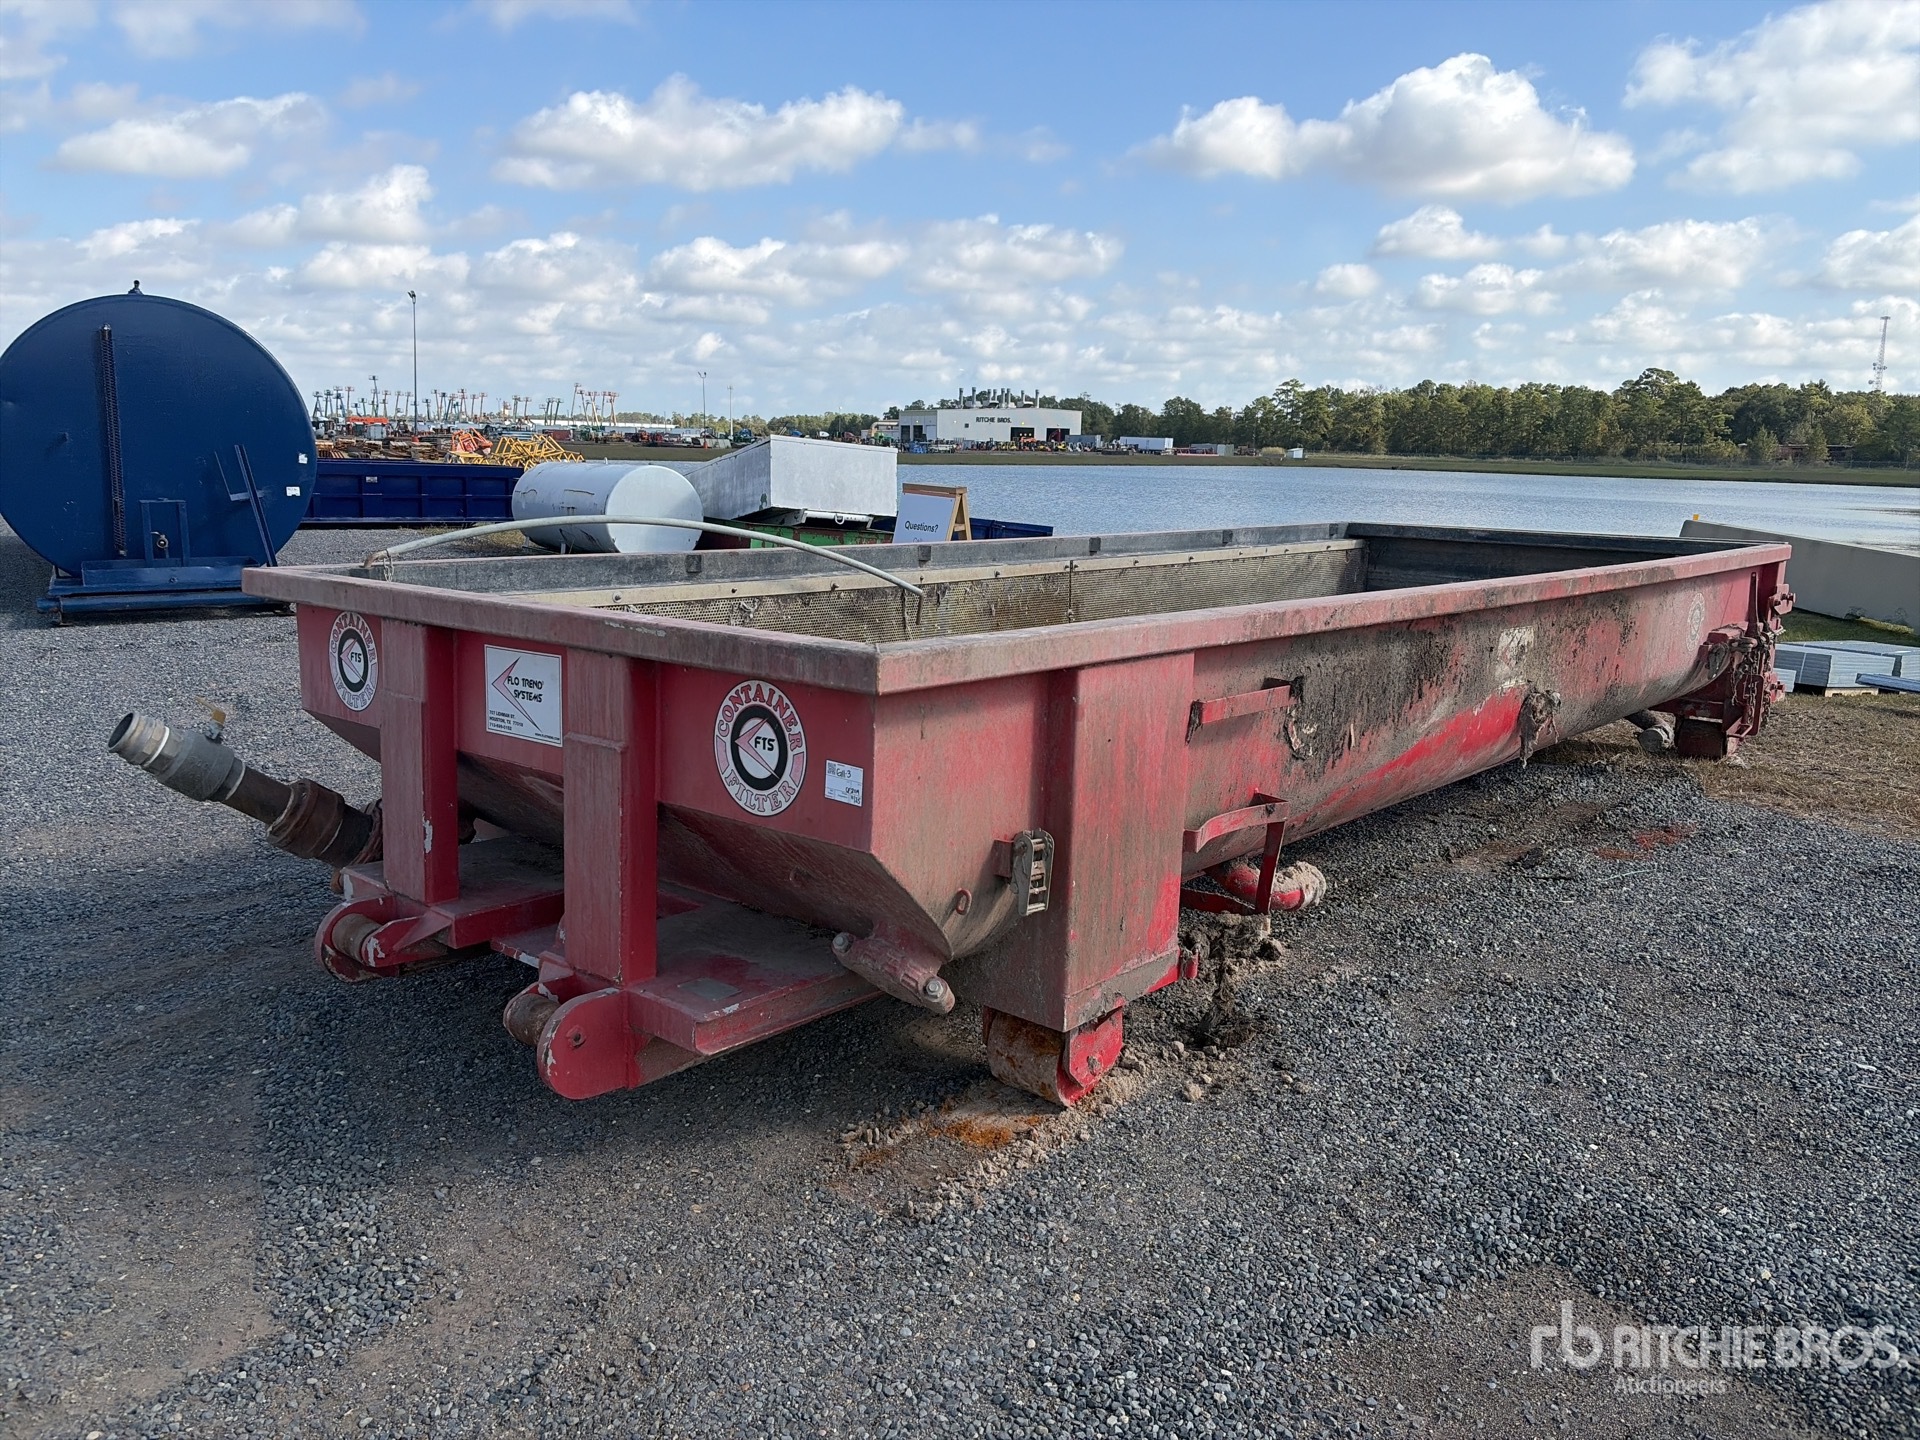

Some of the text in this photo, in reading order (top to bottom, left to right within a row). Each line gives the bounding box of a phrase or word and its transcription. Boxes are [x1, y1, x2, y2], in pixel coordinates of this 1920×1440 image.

[905, 520, 939, 533] Questions?
[331, 612, 377, 663] CONTAINER
[350, 652, 362, 663] FTS
[507, 676, 543, 690] FLO TREND
[335, 676, 374, 708] FILTER
[514, 689, 543, 703] SYSTEMS
[718, 684, 803, 752] CONTAINER
[754, 736, 776, 752] FTS
[724, 769, 796, 813] FILTER
